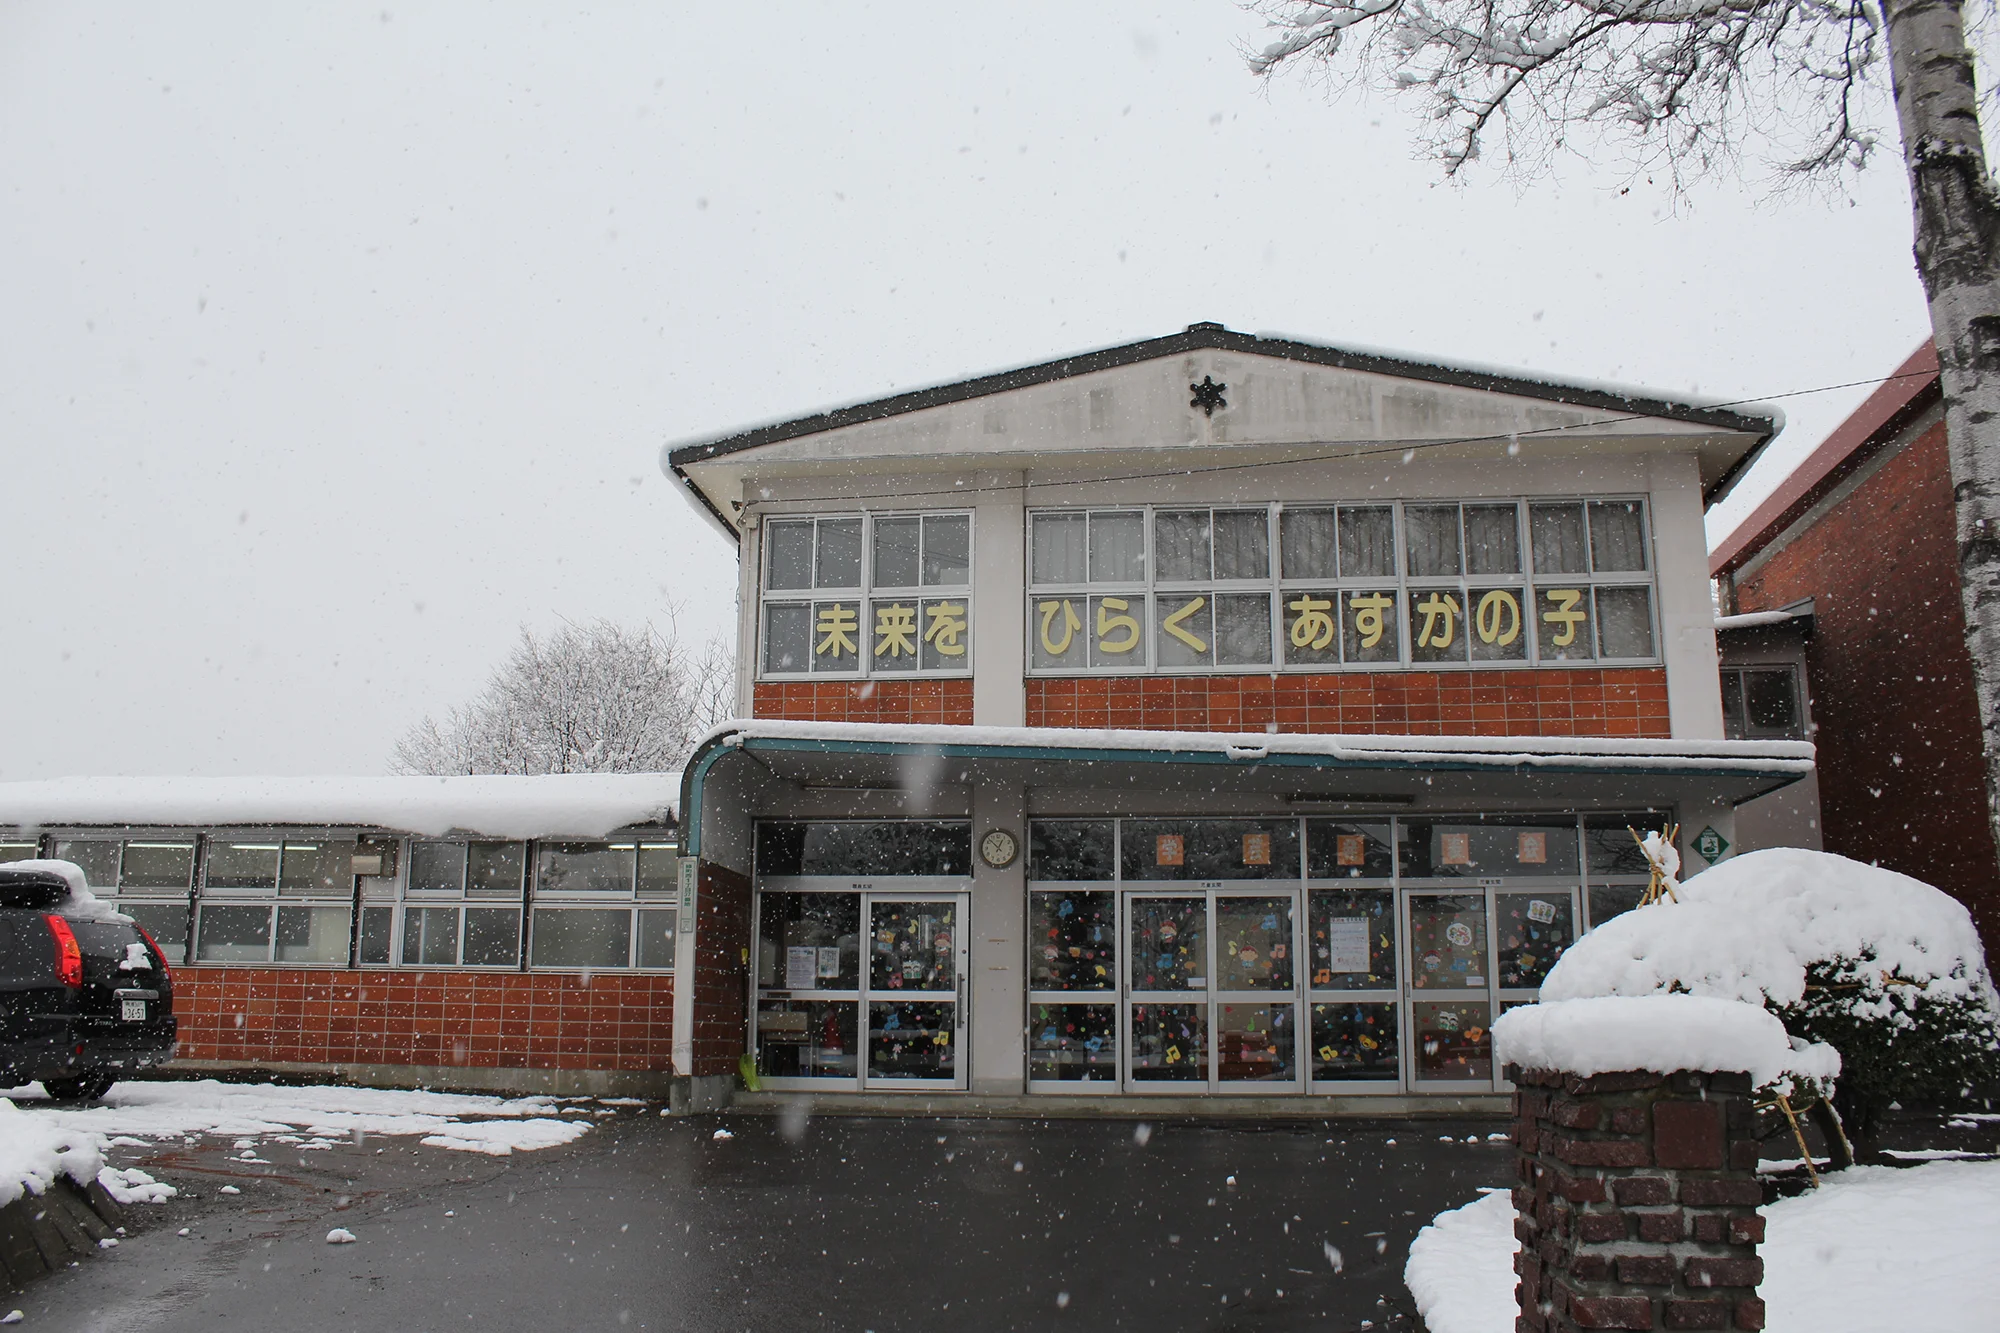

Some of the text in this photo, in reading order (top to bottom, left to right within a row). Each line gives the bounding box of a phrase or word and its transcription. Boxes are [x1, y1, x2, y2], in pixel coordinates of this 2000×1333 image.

[816, 590, 1586, 657] 未来を ひらく あすかの子
